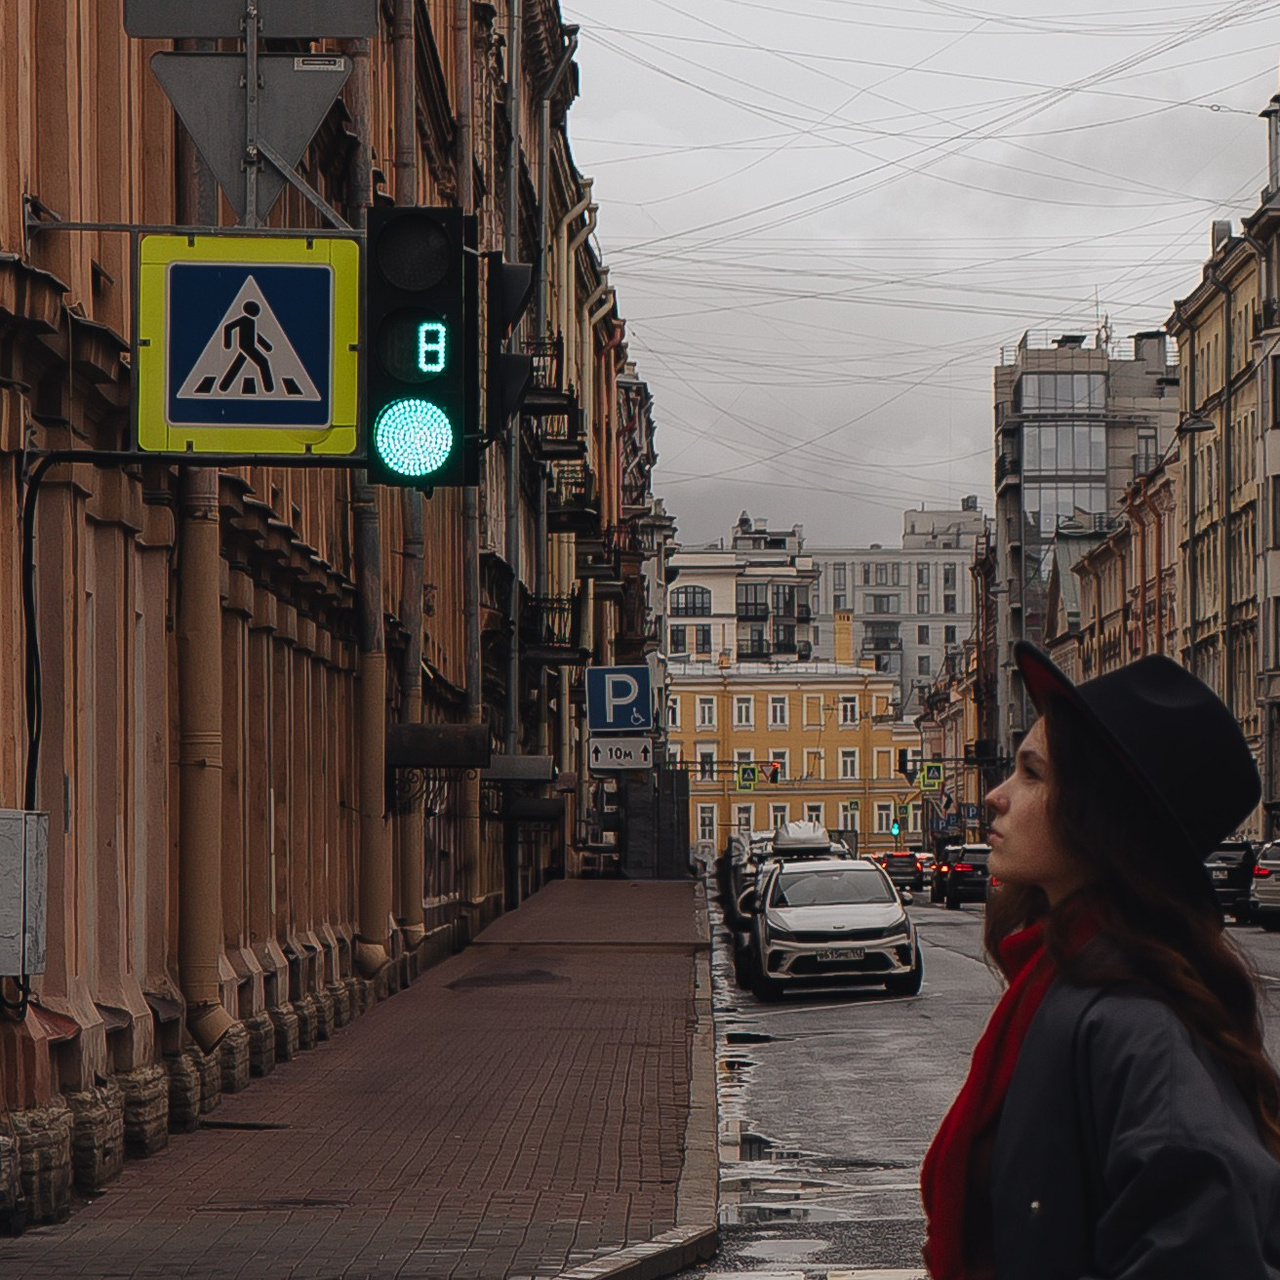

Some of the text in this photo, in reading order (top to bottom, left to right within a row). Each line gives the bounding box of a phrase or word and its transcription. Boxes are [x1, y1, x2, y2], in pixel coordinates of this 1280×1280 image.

[417, 321, 446, 373] 8
[605, 673, 639, 723] P
[607, 746, 633, 760] 10м
